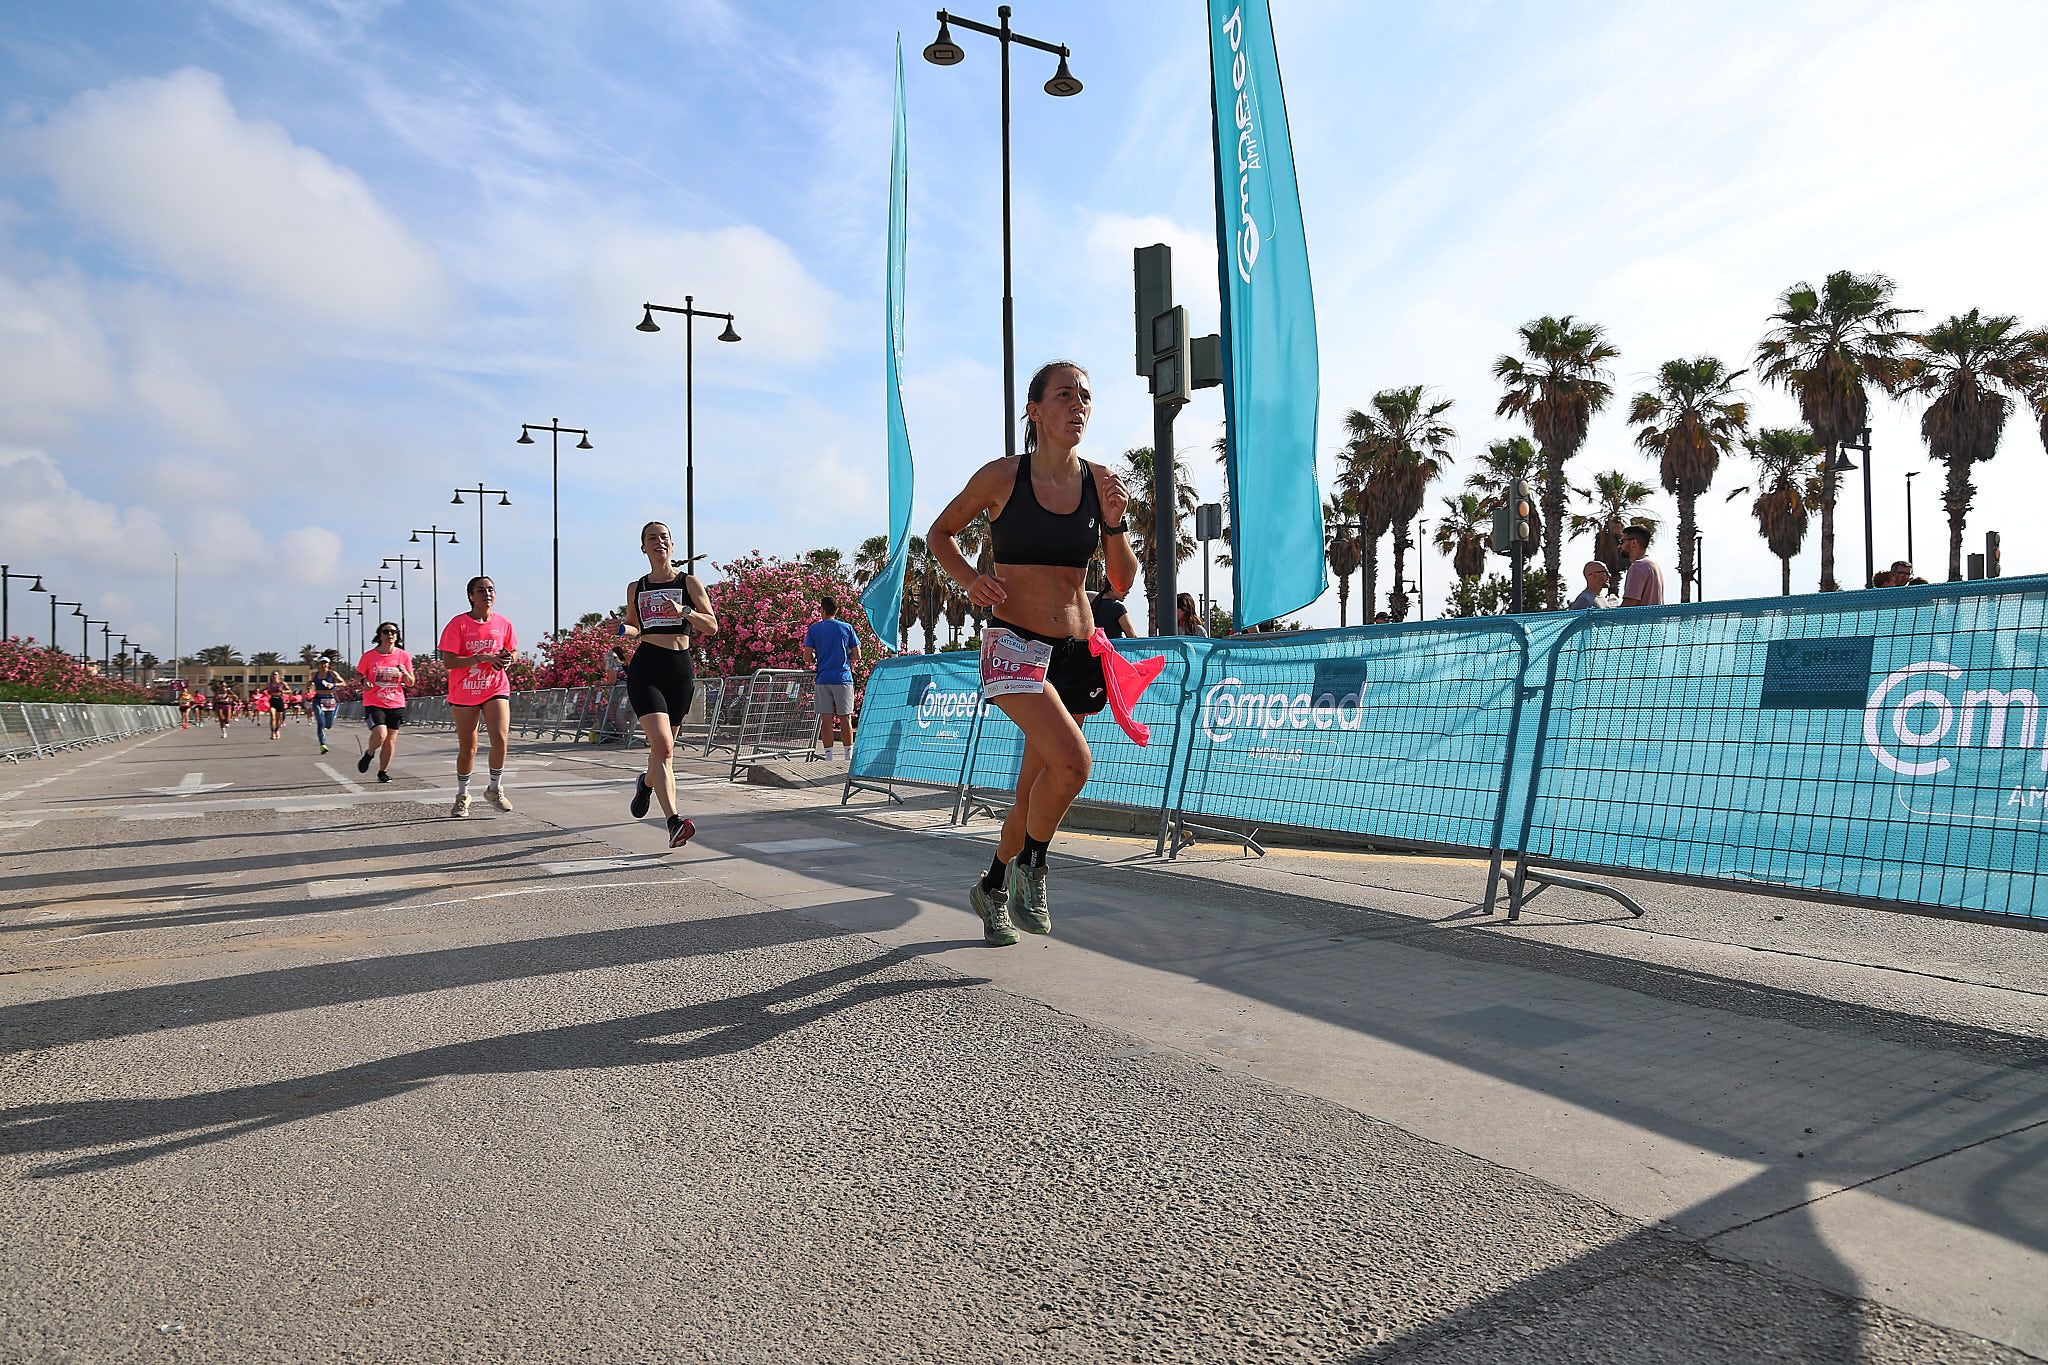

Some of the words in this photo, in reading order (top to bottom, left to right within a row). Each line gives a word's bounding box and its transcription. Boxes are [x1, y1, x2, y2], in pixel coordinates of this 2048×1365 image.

[993, 657, 1020, 672] 016
[1203, 677, 1368, 743] Compeed
[1864, 661, 2048, 775] Com
[1248, 746, 1303, 761] AMPOLLAS
